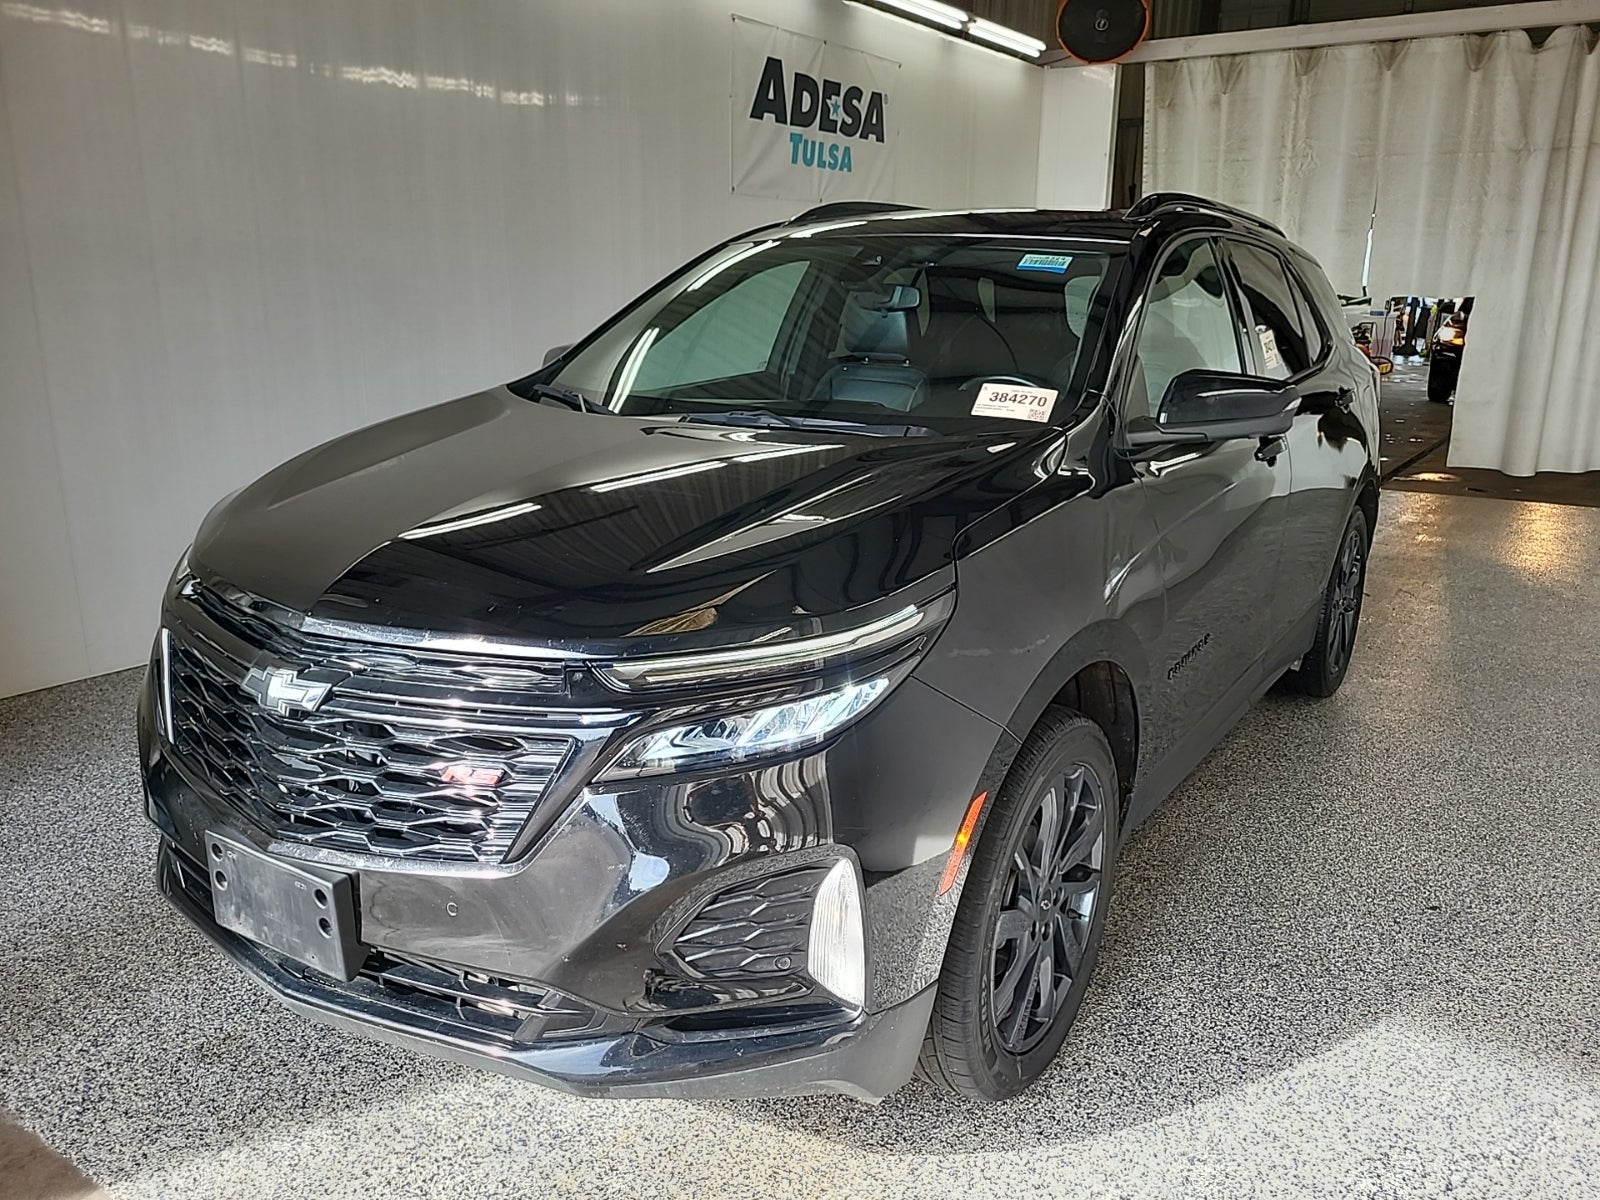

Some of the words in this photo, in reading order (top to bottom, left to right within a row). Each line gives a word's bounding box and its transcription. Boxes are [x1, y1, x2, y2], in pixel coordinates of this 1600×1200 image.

[750, 56, 885, 143] ADESA
[789, 132, 852, 172] TULSA
[989, 391, 1048, 407] 384270
